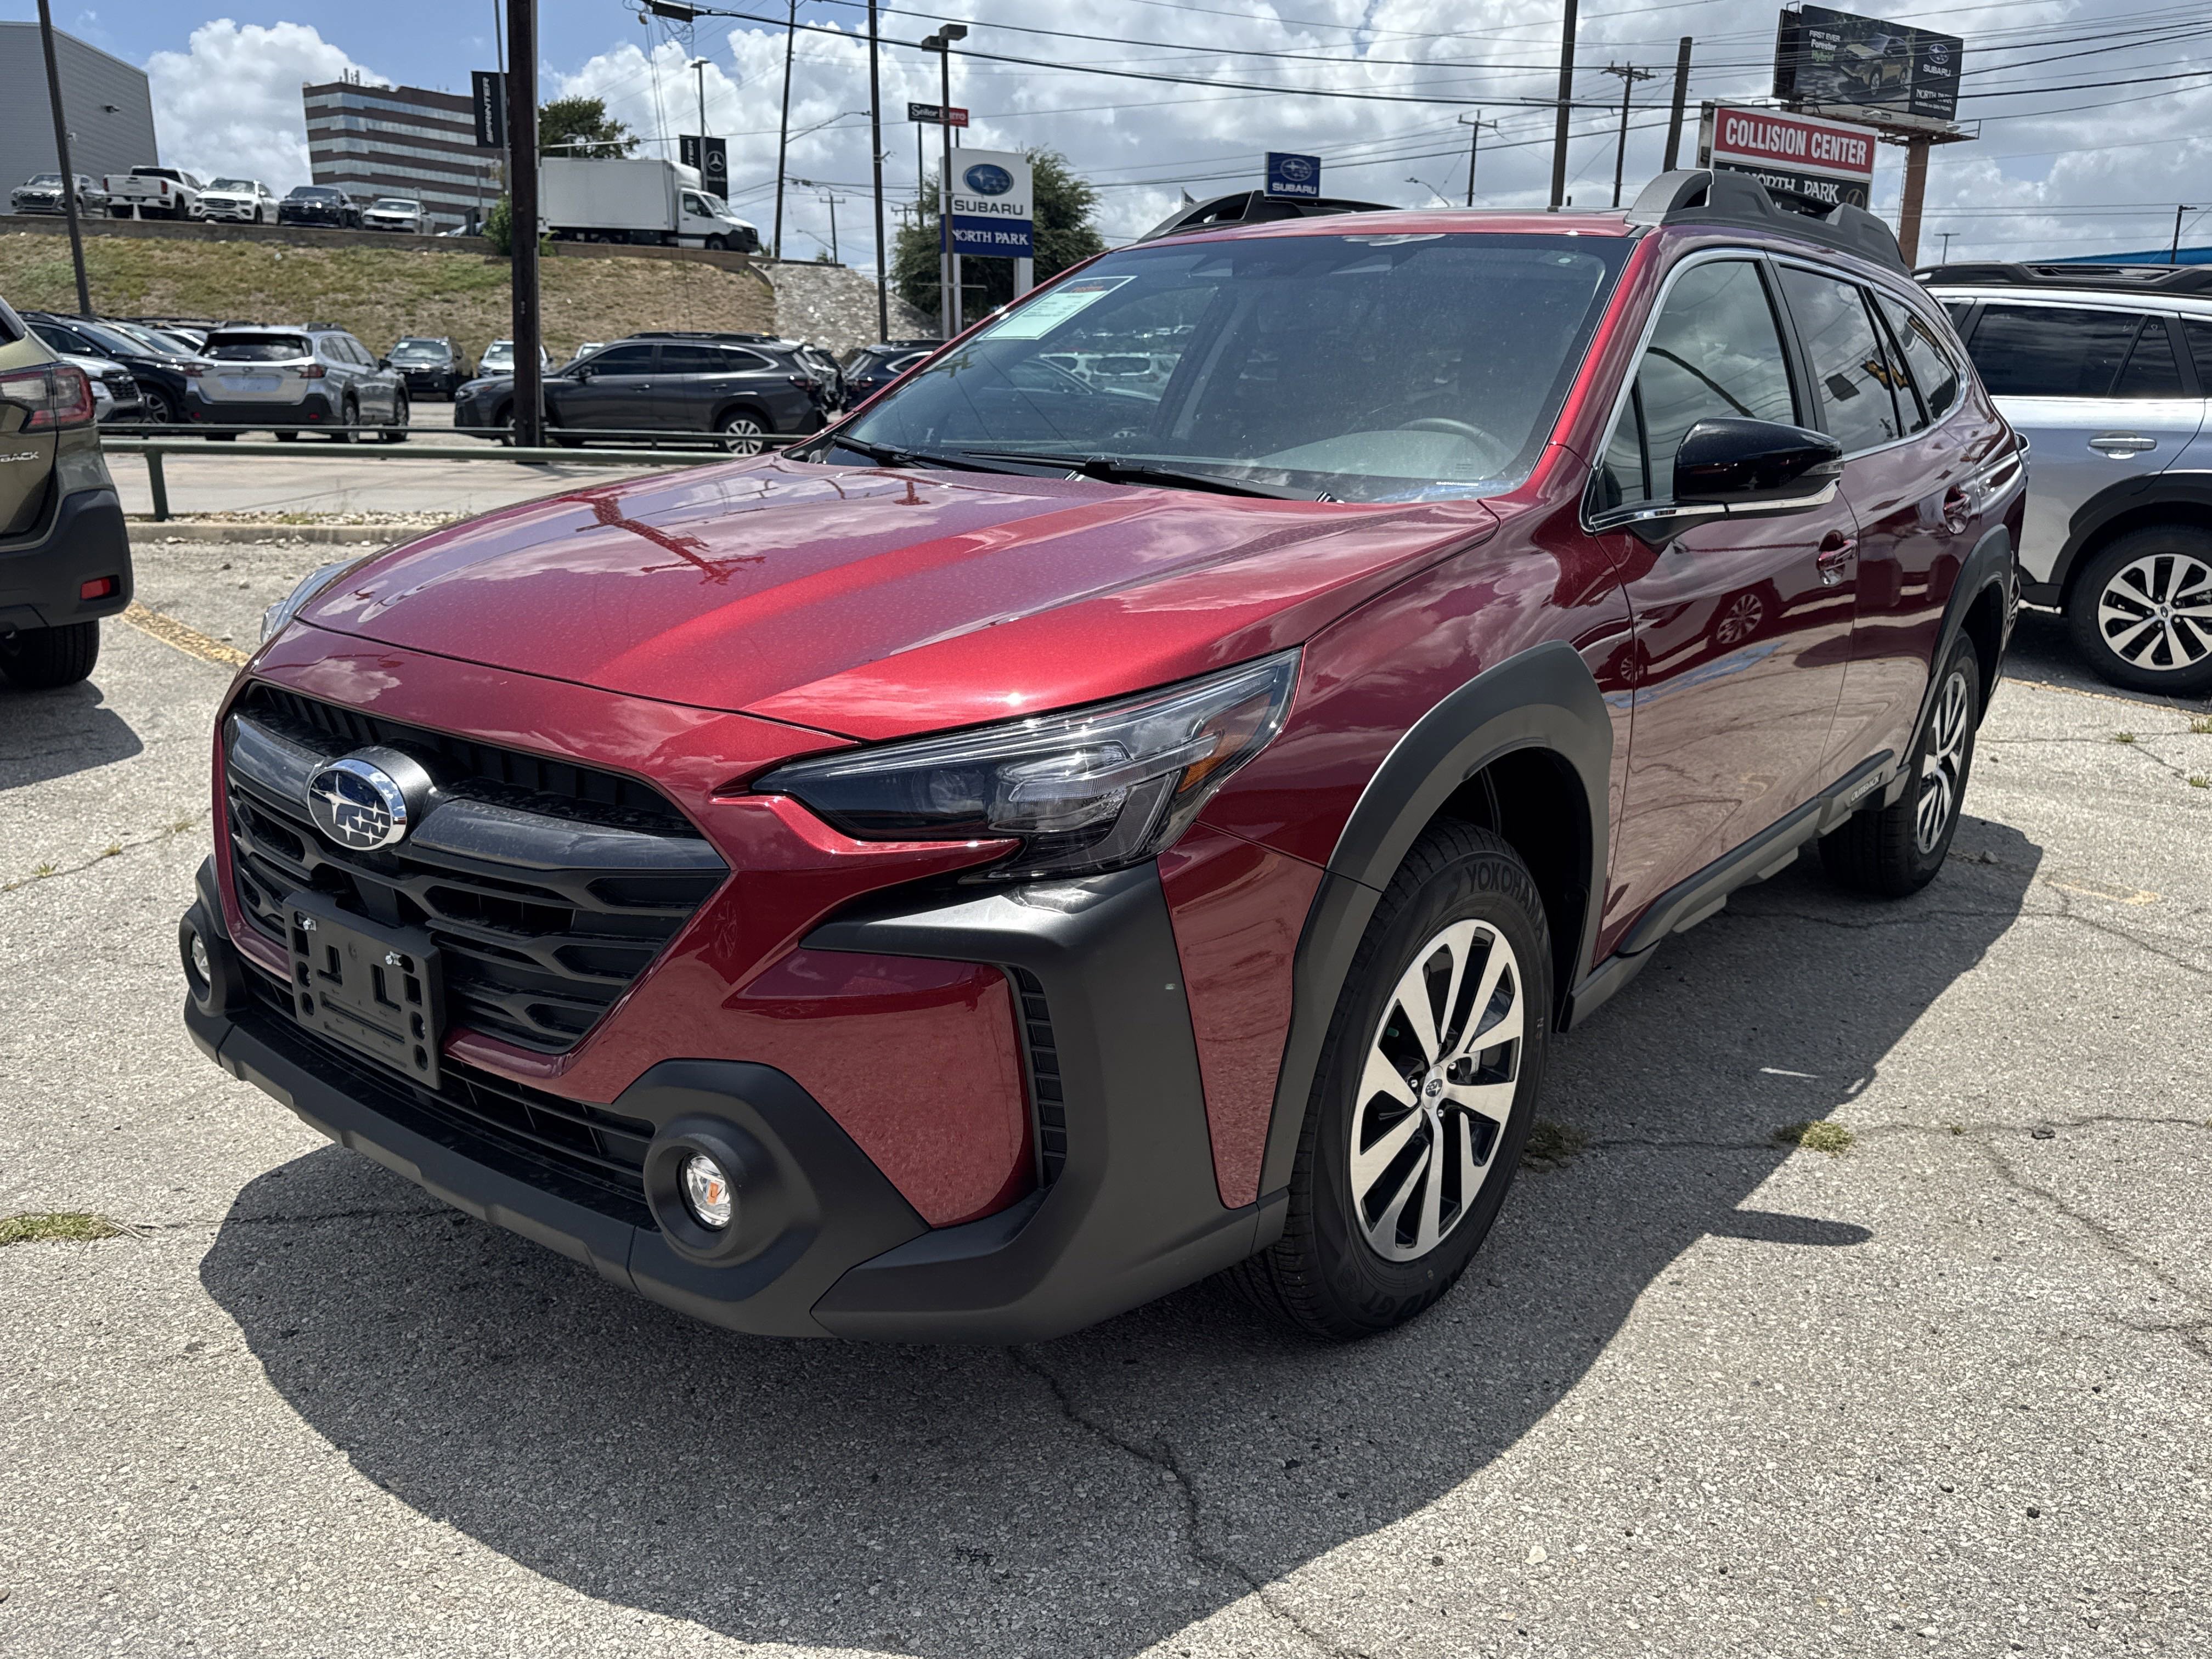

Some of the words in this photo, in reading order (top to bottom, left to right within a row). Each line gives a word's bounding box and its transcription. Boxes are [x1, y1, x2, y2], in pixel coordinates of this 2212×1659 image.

[1923, 64, 1951, 77] SUBARU
[1916, 88, 1937, 99] NORTH
[482, 77, 494, 143] SPRINTER
[1725, 117, 1807, 156] COLLISION
[1810, 132, 1867, 165] CENTER
[1272, 182, 1317, 195] SUBARU
[1746, 171, 1796, 191] ORTH
[1803, 180, 1840, 204] PARK
[954, 200, 1024, 216] SUBARU
[994, 232, 1029, 245] PARK
[1851, 775, 1880, 801] OUTBACK
